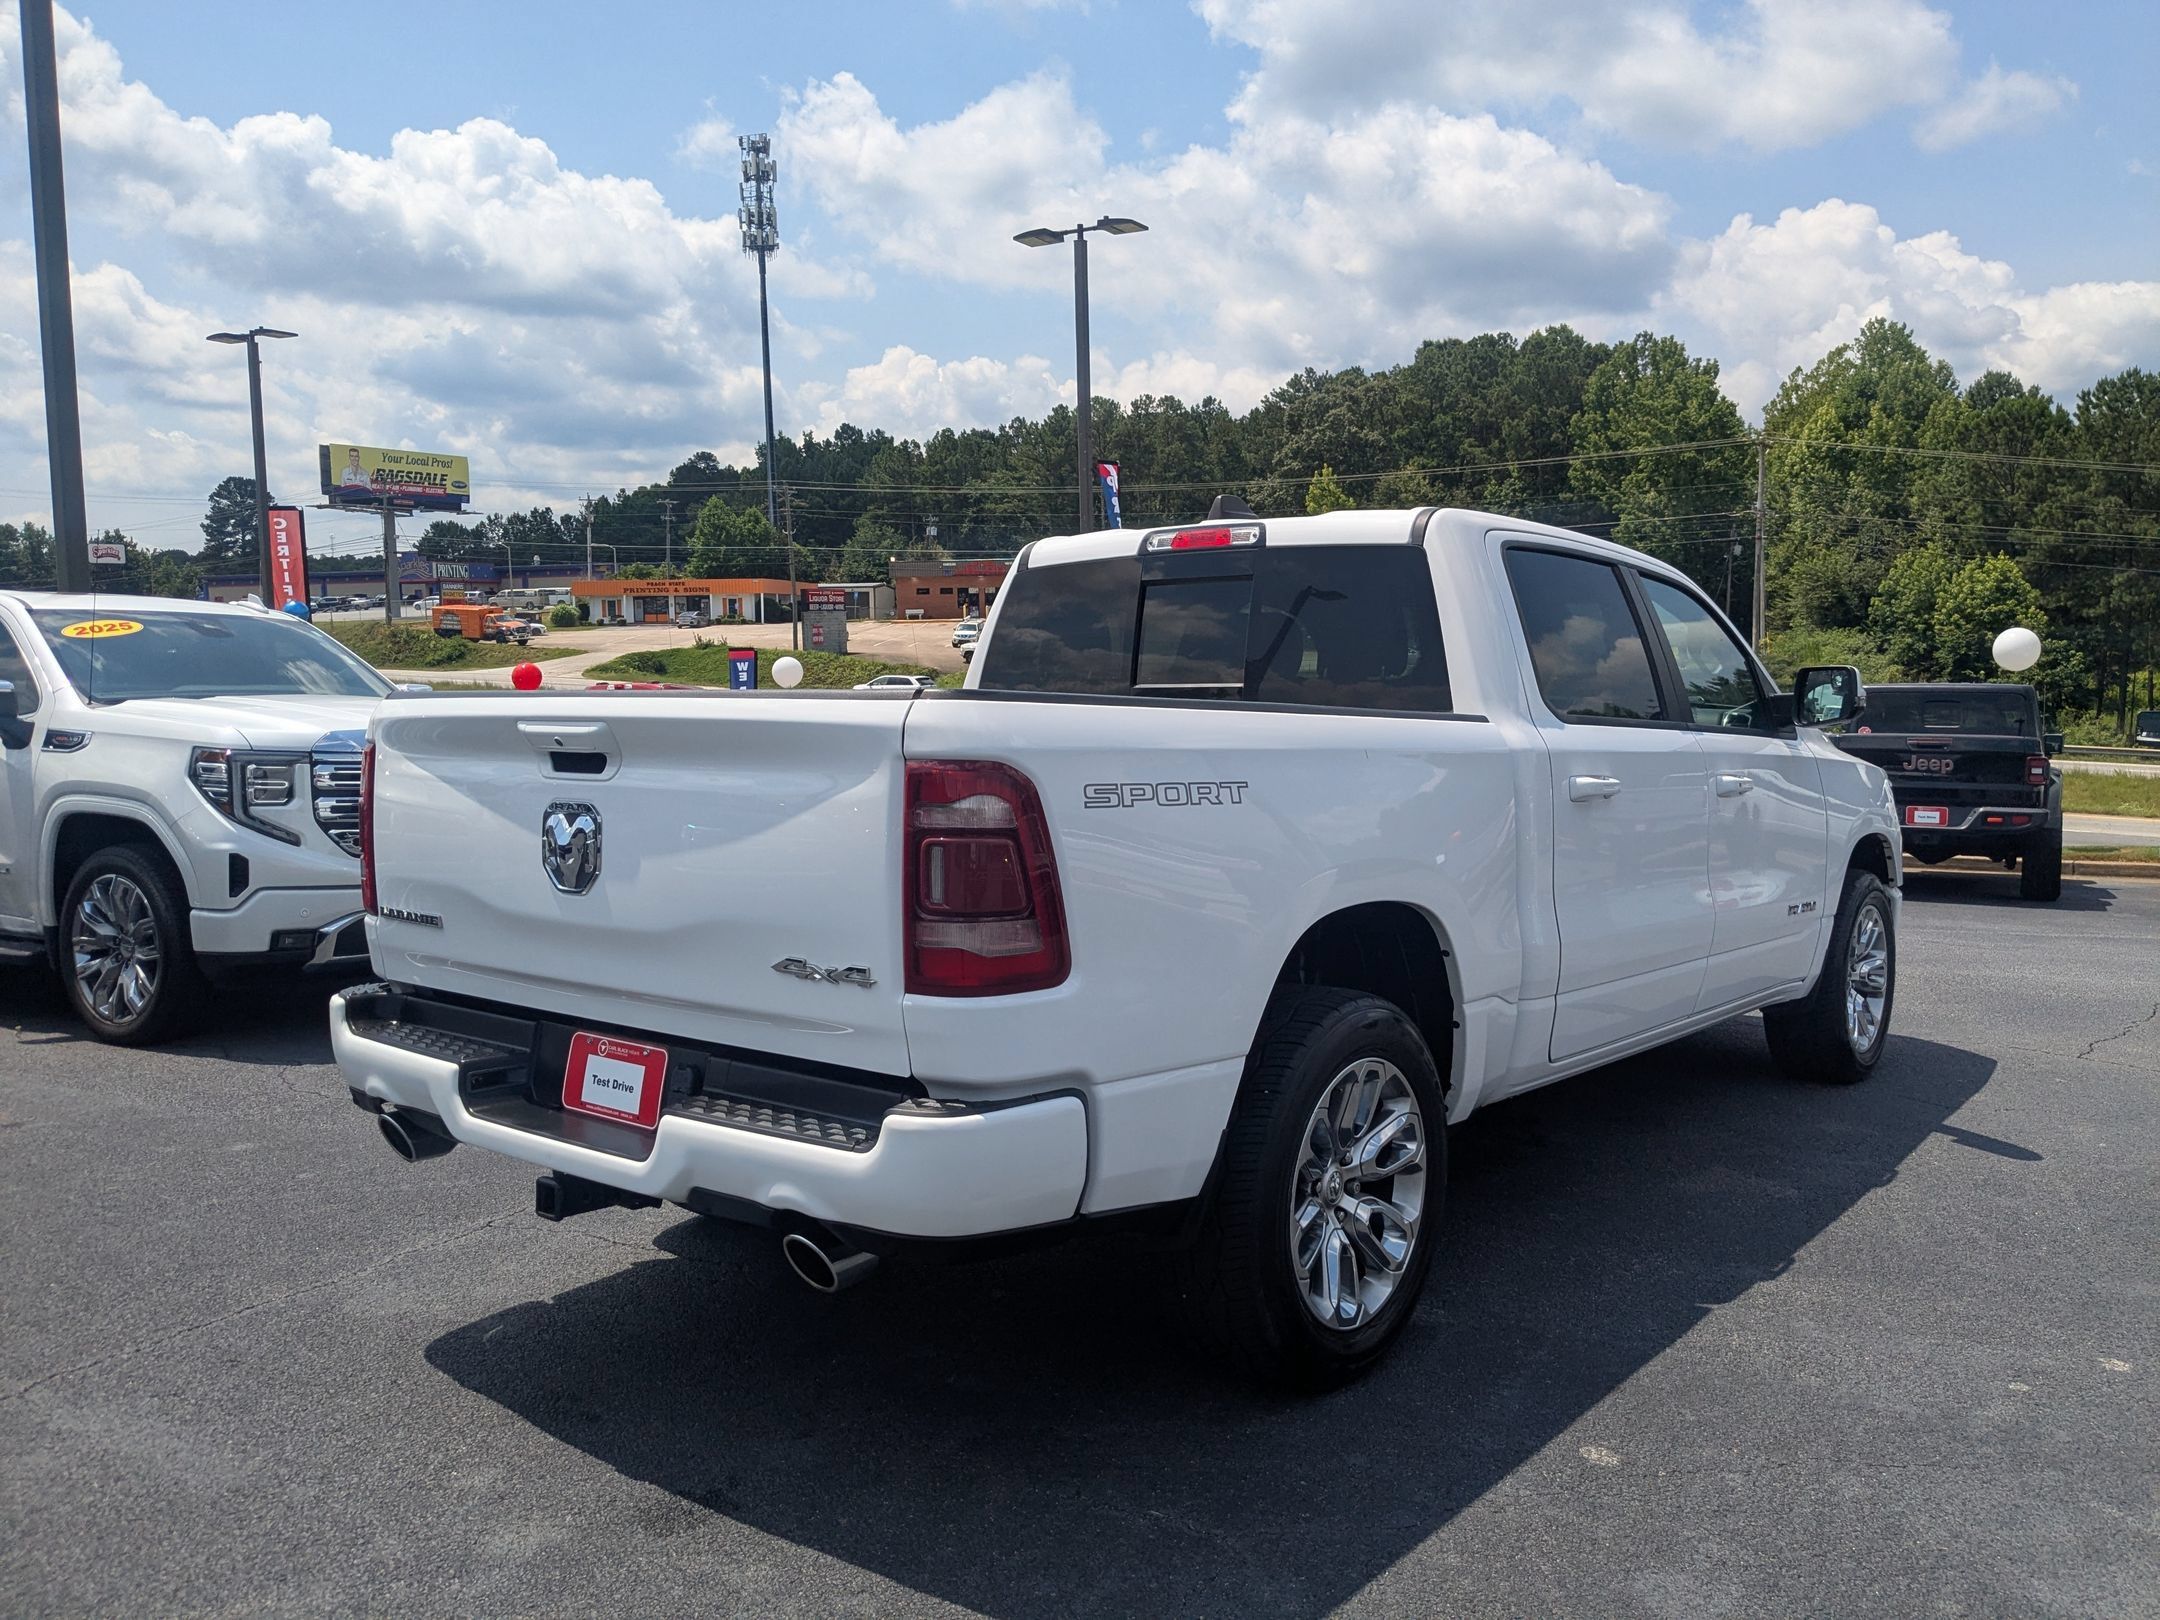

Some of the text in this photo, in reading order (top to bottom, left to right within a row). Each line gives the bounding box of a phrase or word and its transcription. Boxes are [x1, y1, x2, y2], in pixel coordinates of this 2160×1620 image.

[381, 452, 453, 469] Your Local Pros!
[375, 468, 448, 486] RAGSDALE
[437, 564, 469, 578] PRINTING
[73, 622, 134, 636] 2025
[1903, 755, 1954, 774] Jeep
[1083, 781, 1249, 809] SPORT
[592, 1074, 634, 1093] Test Drive
